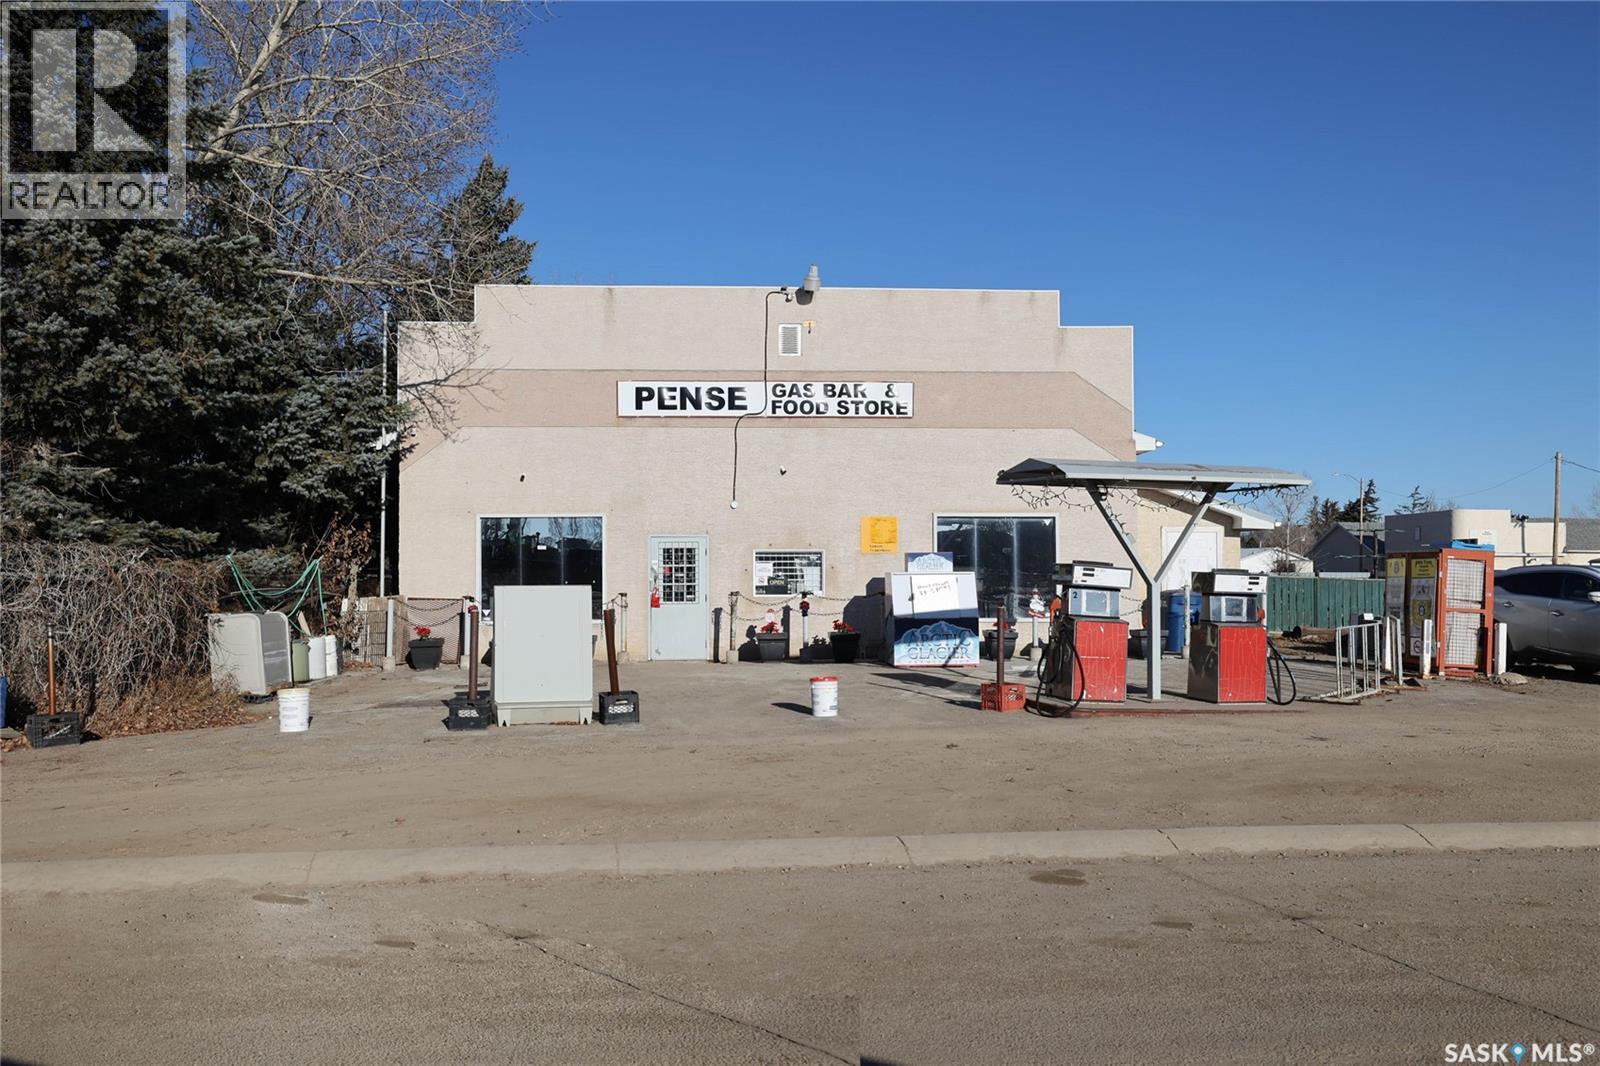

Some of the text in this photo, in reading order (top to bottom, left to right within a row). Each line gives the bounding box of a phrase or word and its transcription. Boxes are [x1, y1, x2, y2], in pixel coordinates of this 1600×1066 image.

[634, 386, 748, 411] PENSE
[771, 383, 898, 399] GAS BAR &
[771, 400, 909, 416] FOOD STORE
[1072, 591, 1079, 599] 2
[906, 630, 972, 647] ARCTIC
[907, 647, 972, 660] GLACIER
